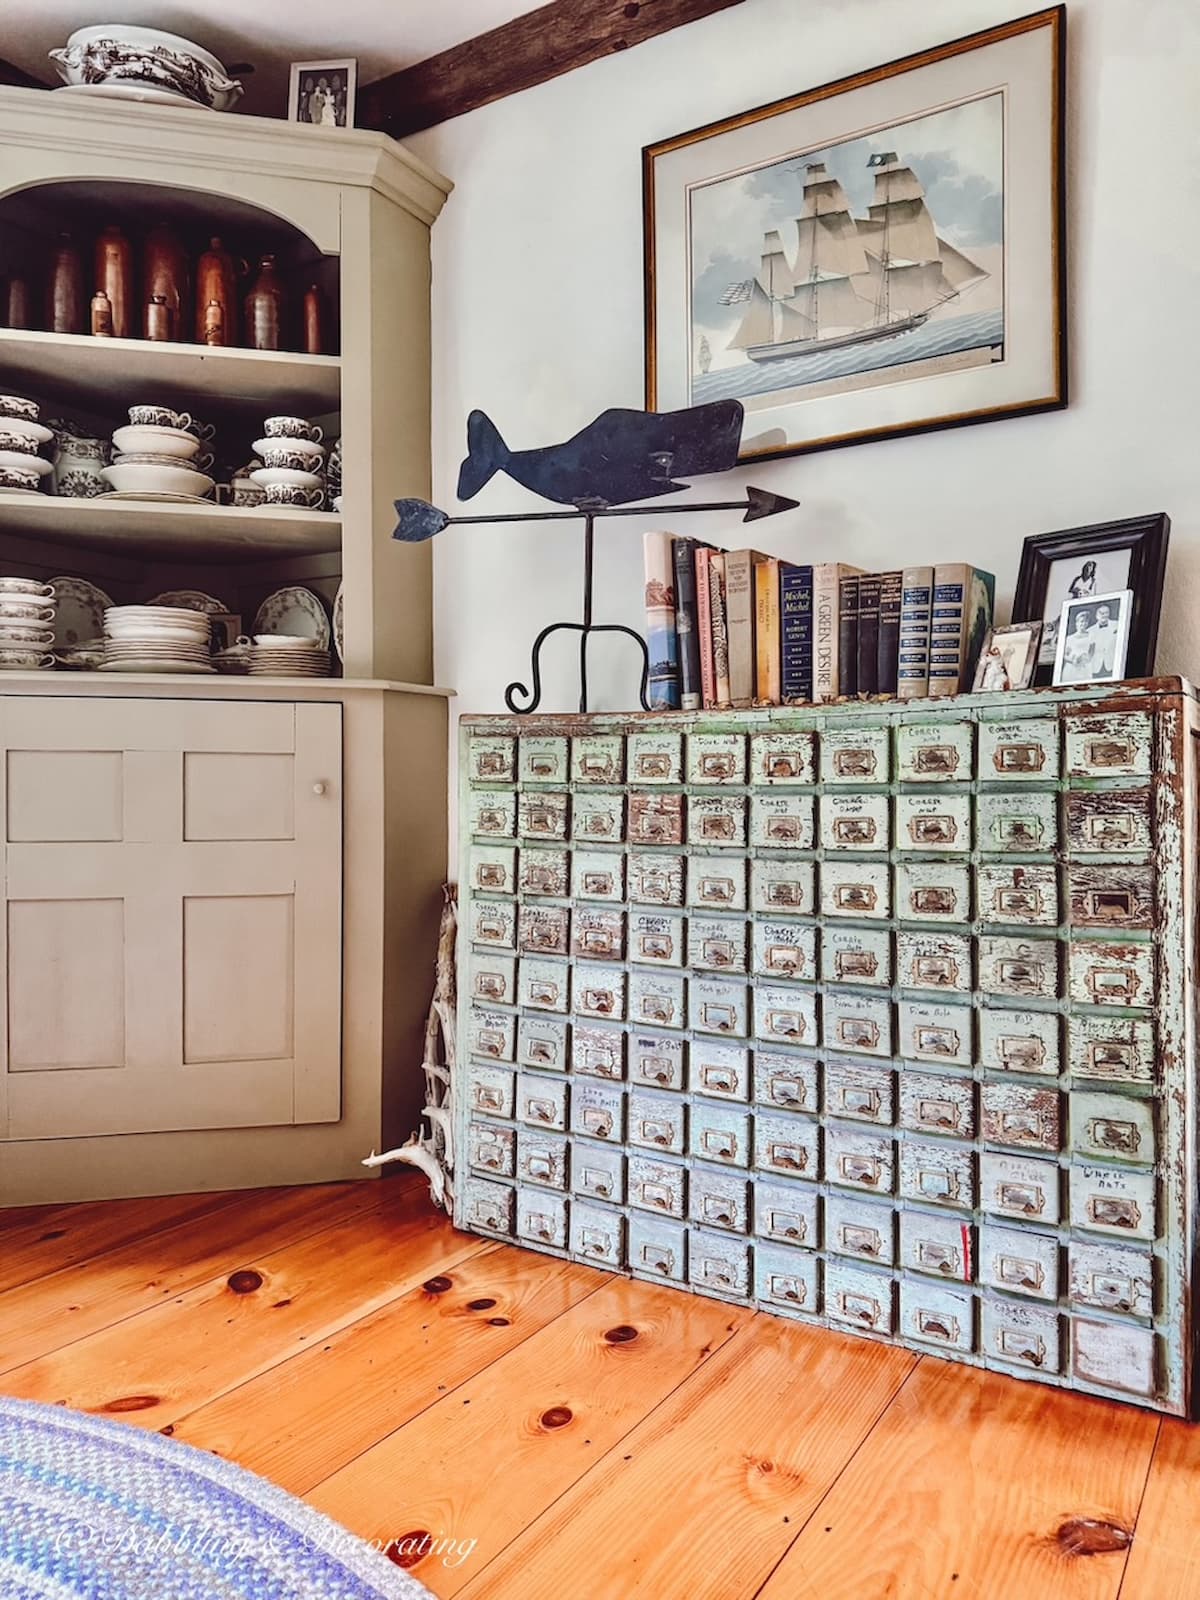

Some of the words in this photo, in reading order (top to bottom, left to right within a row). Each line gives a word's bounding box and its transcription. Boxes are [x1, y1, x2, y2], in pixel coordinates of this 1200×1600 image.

[818, 594, 831, 603] A
[818, 604, 832, 642] GREEN
[817, 647, 832, 687] DESIRE
